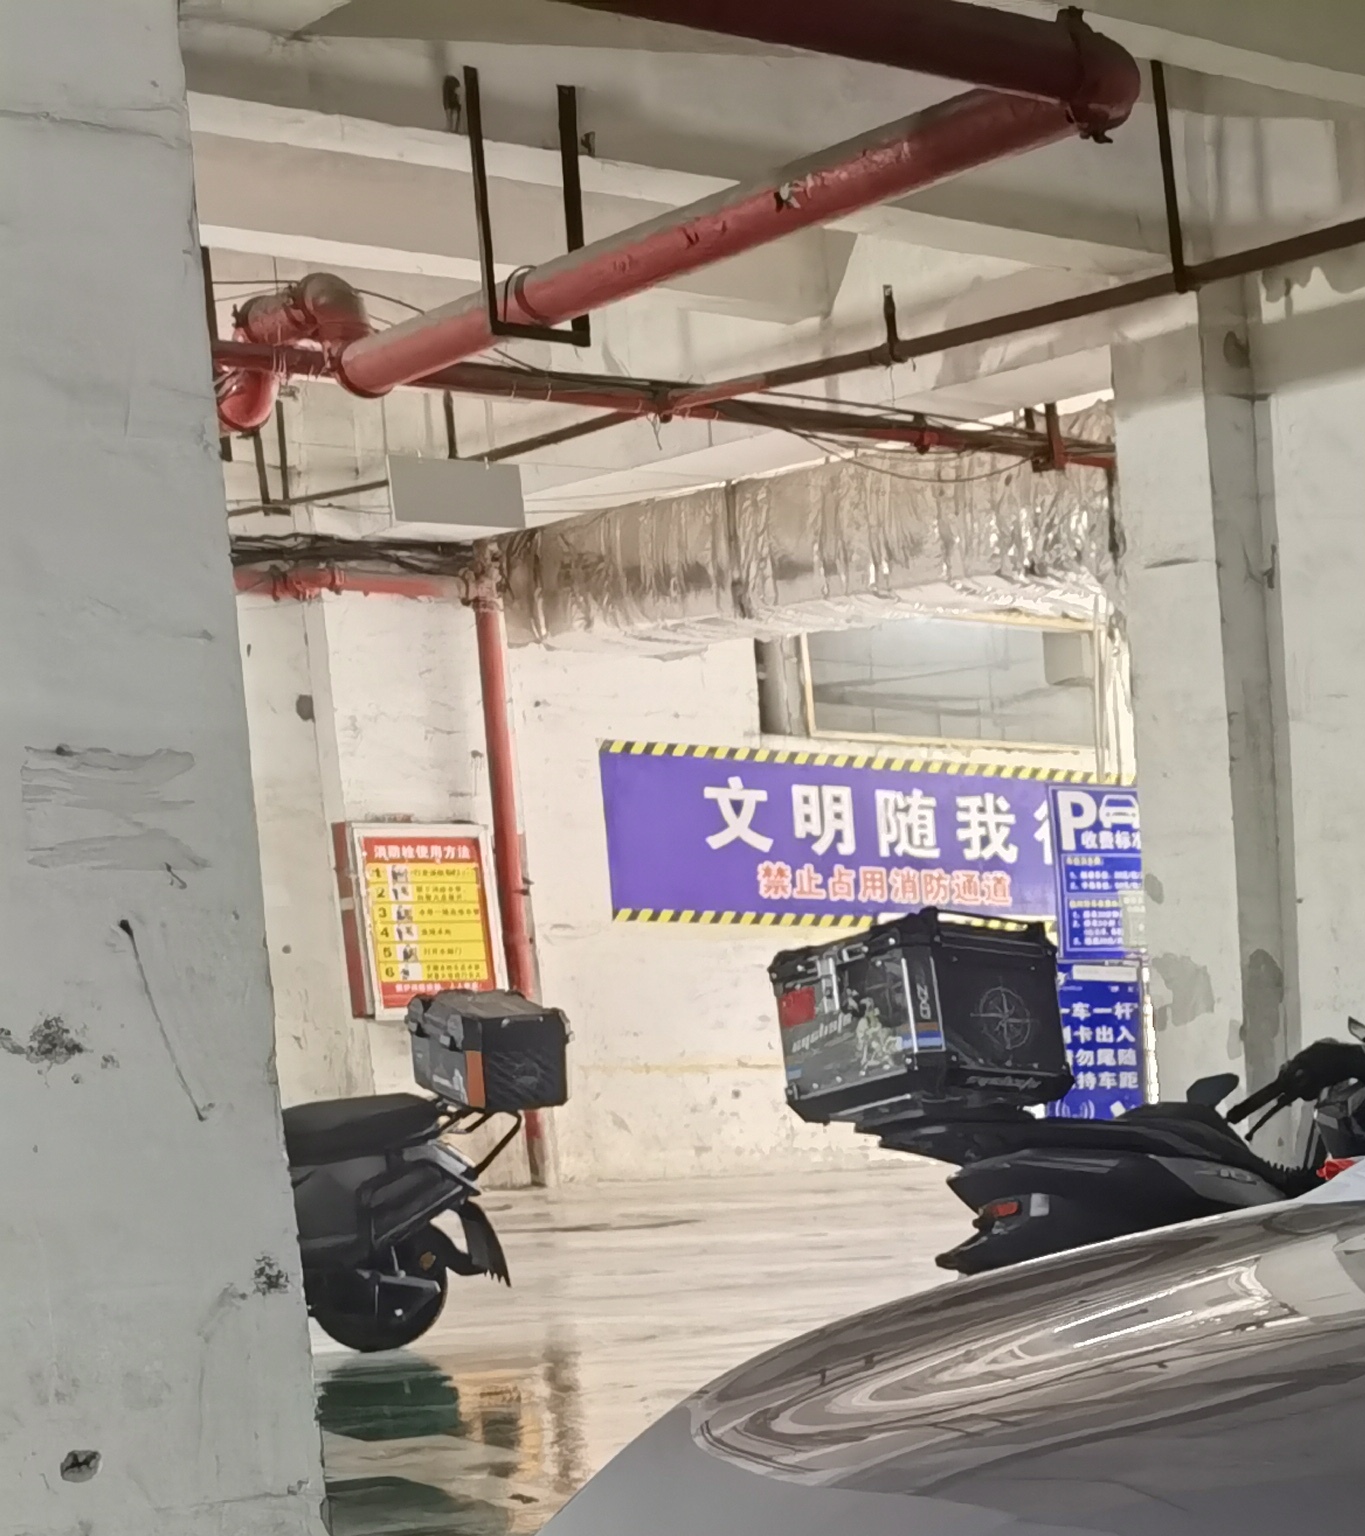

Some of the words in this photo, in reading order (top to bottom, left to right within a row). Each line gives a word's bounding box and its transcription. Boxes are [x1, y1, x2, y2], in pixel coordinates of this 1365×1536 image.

[1057, 790, 1097, 851] P
[757, 861, 1013, 906] 禁止占用消防通道
[376, 888, 386, 899] 2
[378, 907, 387, 918] 3
[380, 927, 389, 938] 4
[383, 947, 392, 958] 5
[385, 967, 395, 978] 6
[1072, 1071, 1139, 1090] 持车距
